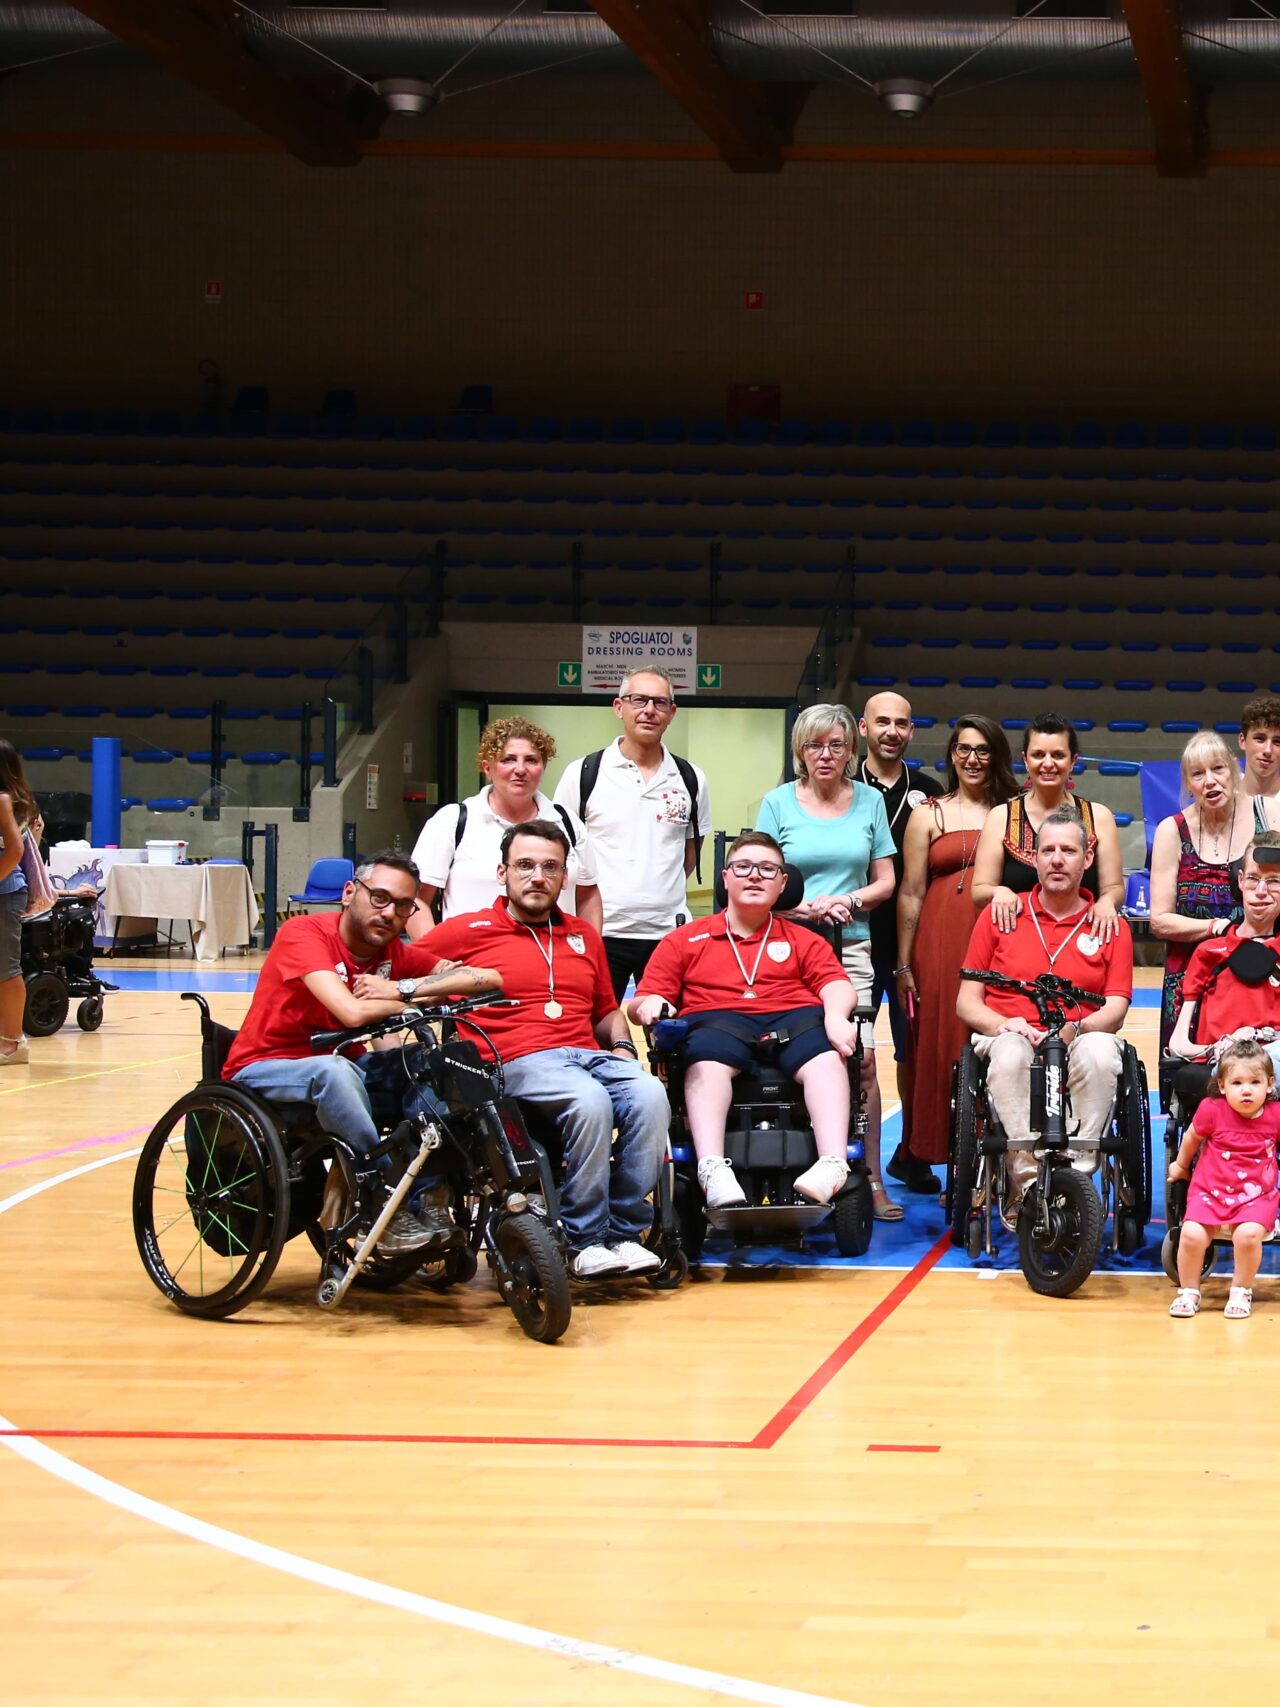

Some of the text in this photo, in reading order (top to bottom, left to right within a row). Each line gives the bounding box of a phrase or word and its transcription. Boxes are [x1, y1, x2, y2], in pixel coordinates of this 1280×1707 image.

[609, 631, 673, 645] SPOGLIATOI
[587, 647, 693, 656] DRESSING ROOMS
